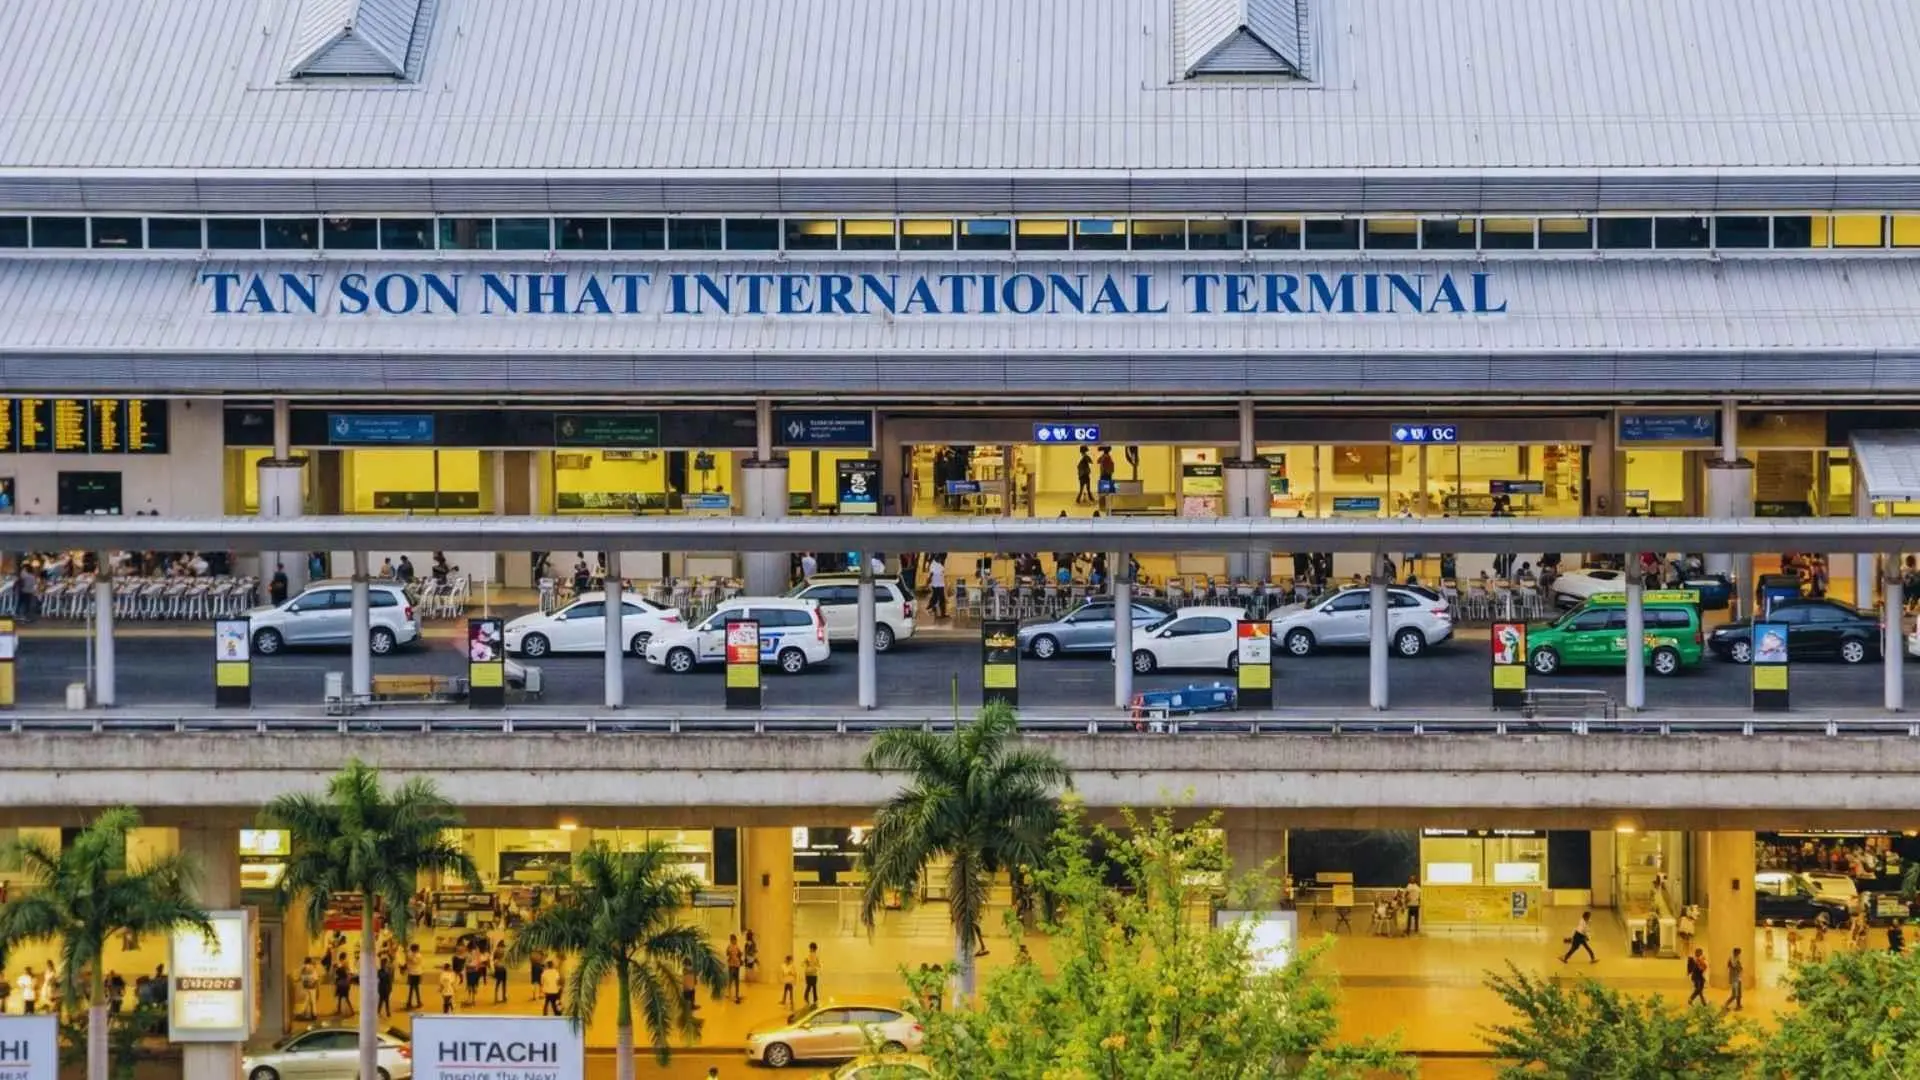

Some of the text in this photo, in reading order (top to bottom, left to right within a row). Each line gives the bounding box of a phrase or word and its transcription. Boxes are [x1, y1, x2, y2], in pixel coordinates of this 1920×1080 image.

[201, 271, 1508, 315] TAN SON NHAT INTERNATIONAL TERMINAL
[438, 1041, 557, 1063] HITACHI
